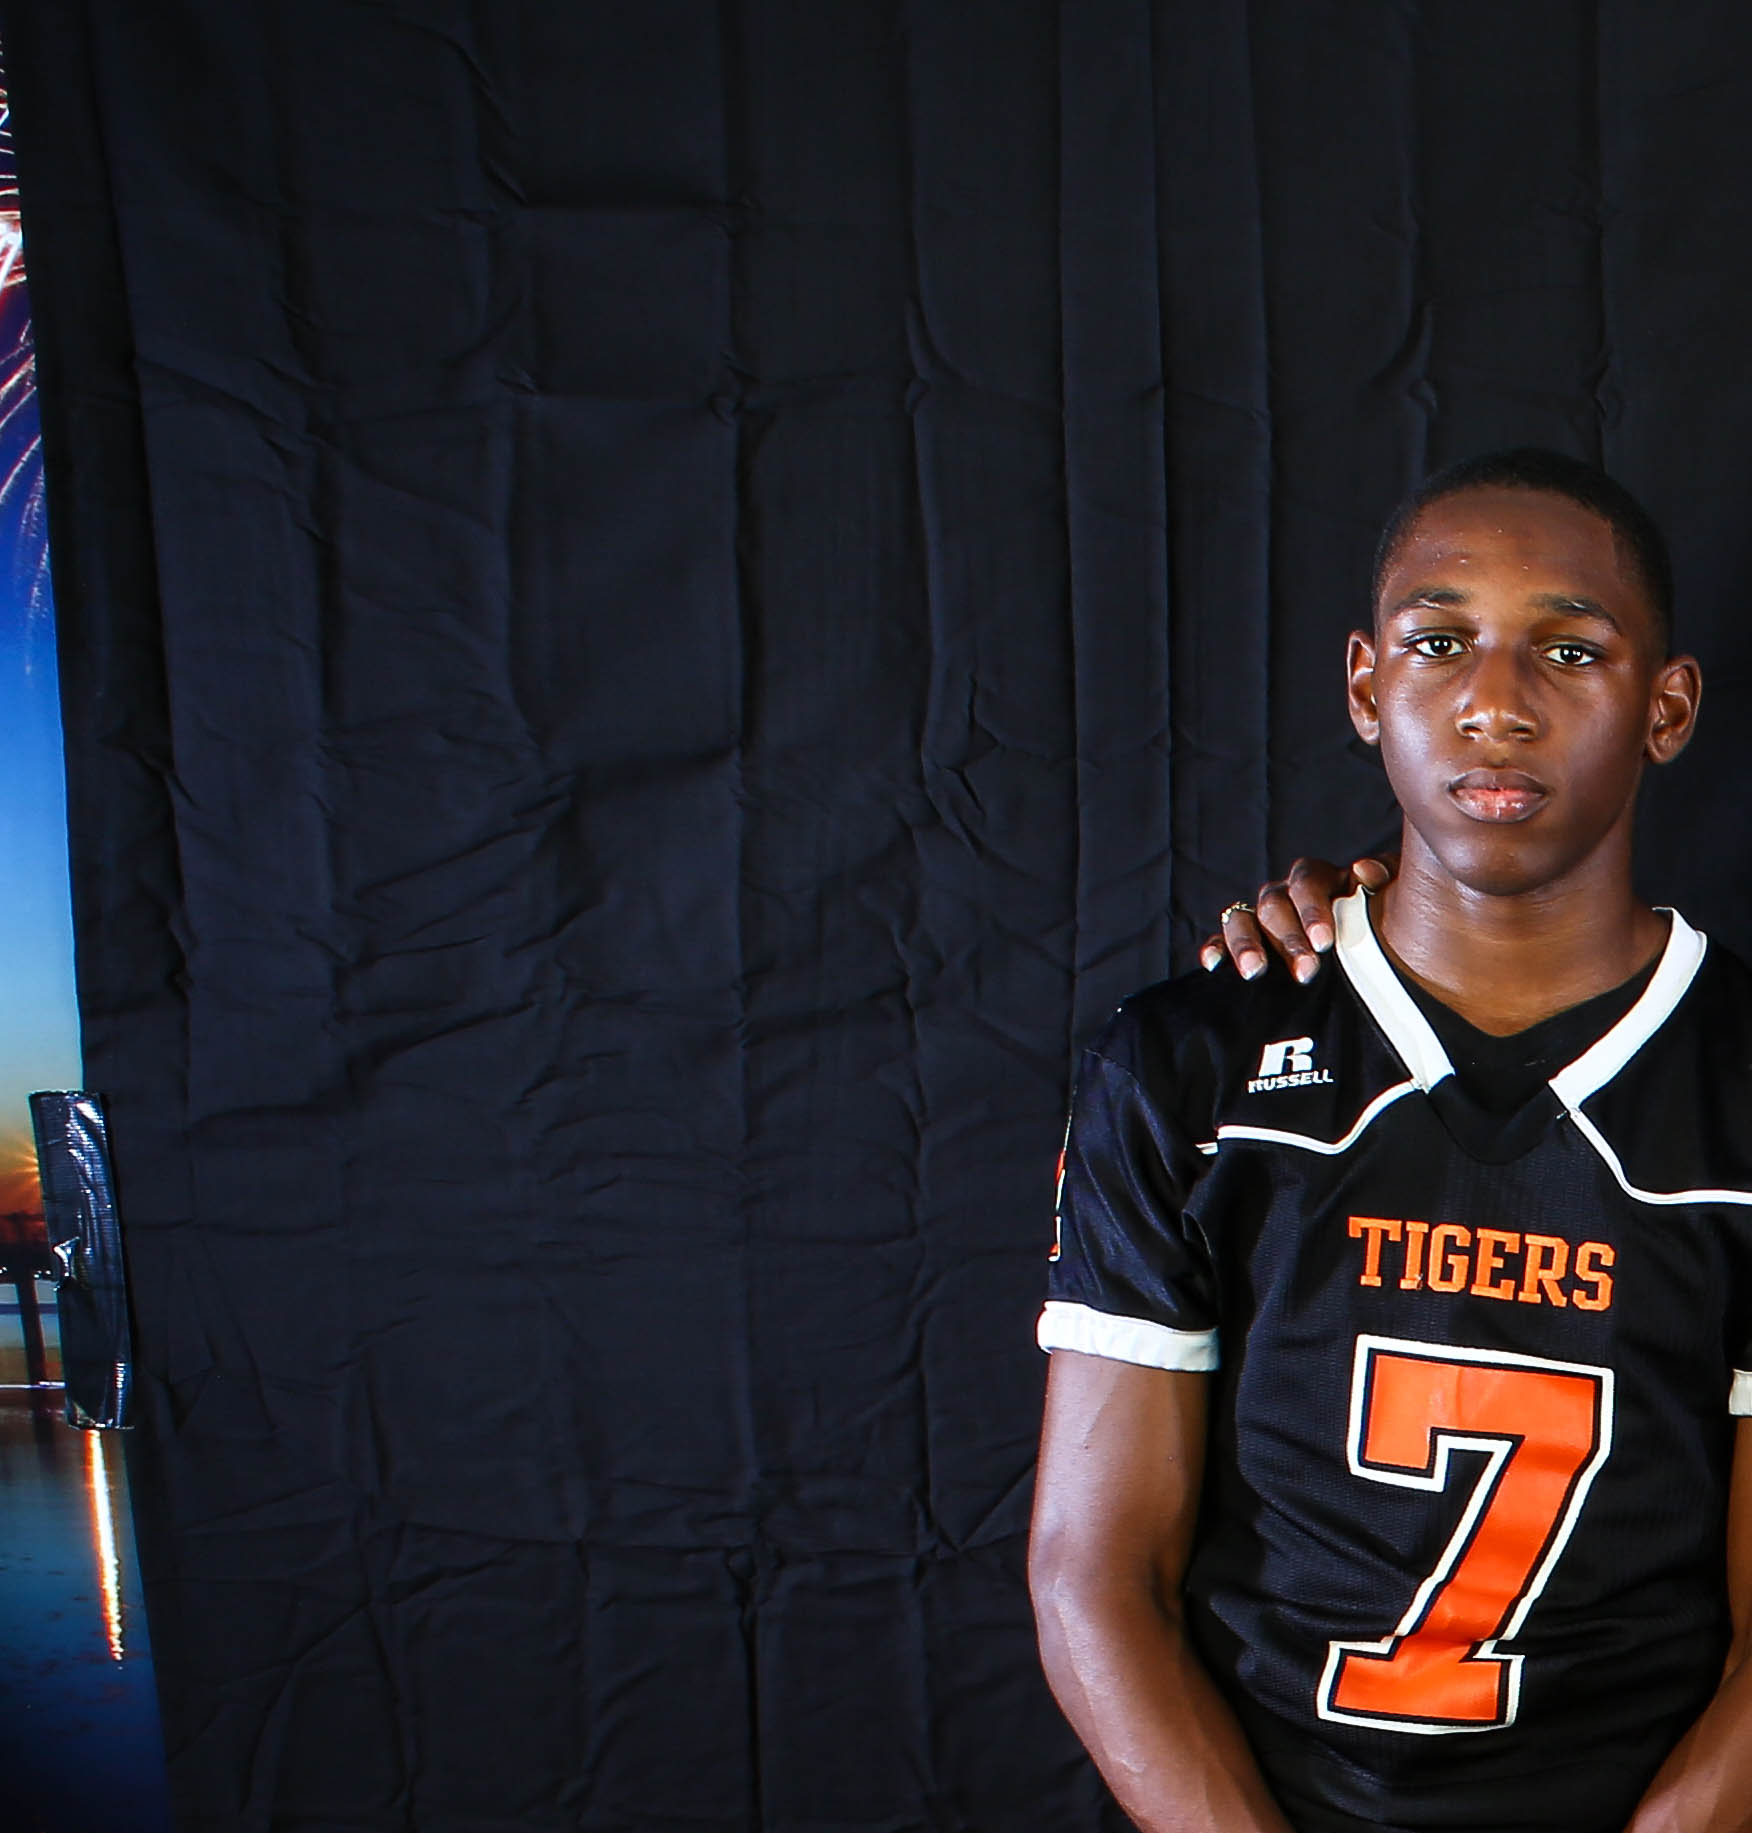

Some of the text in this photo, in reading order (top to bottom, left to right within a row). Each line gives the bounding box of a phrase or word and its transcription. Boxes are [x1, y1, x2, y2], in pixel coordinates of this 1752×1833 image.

[1248, 1069, 1334, 1093] RUSSELL
[1348, 1216, 1615, 1311] TIGERS
[1317, 1333, 1615, 1735] 7
